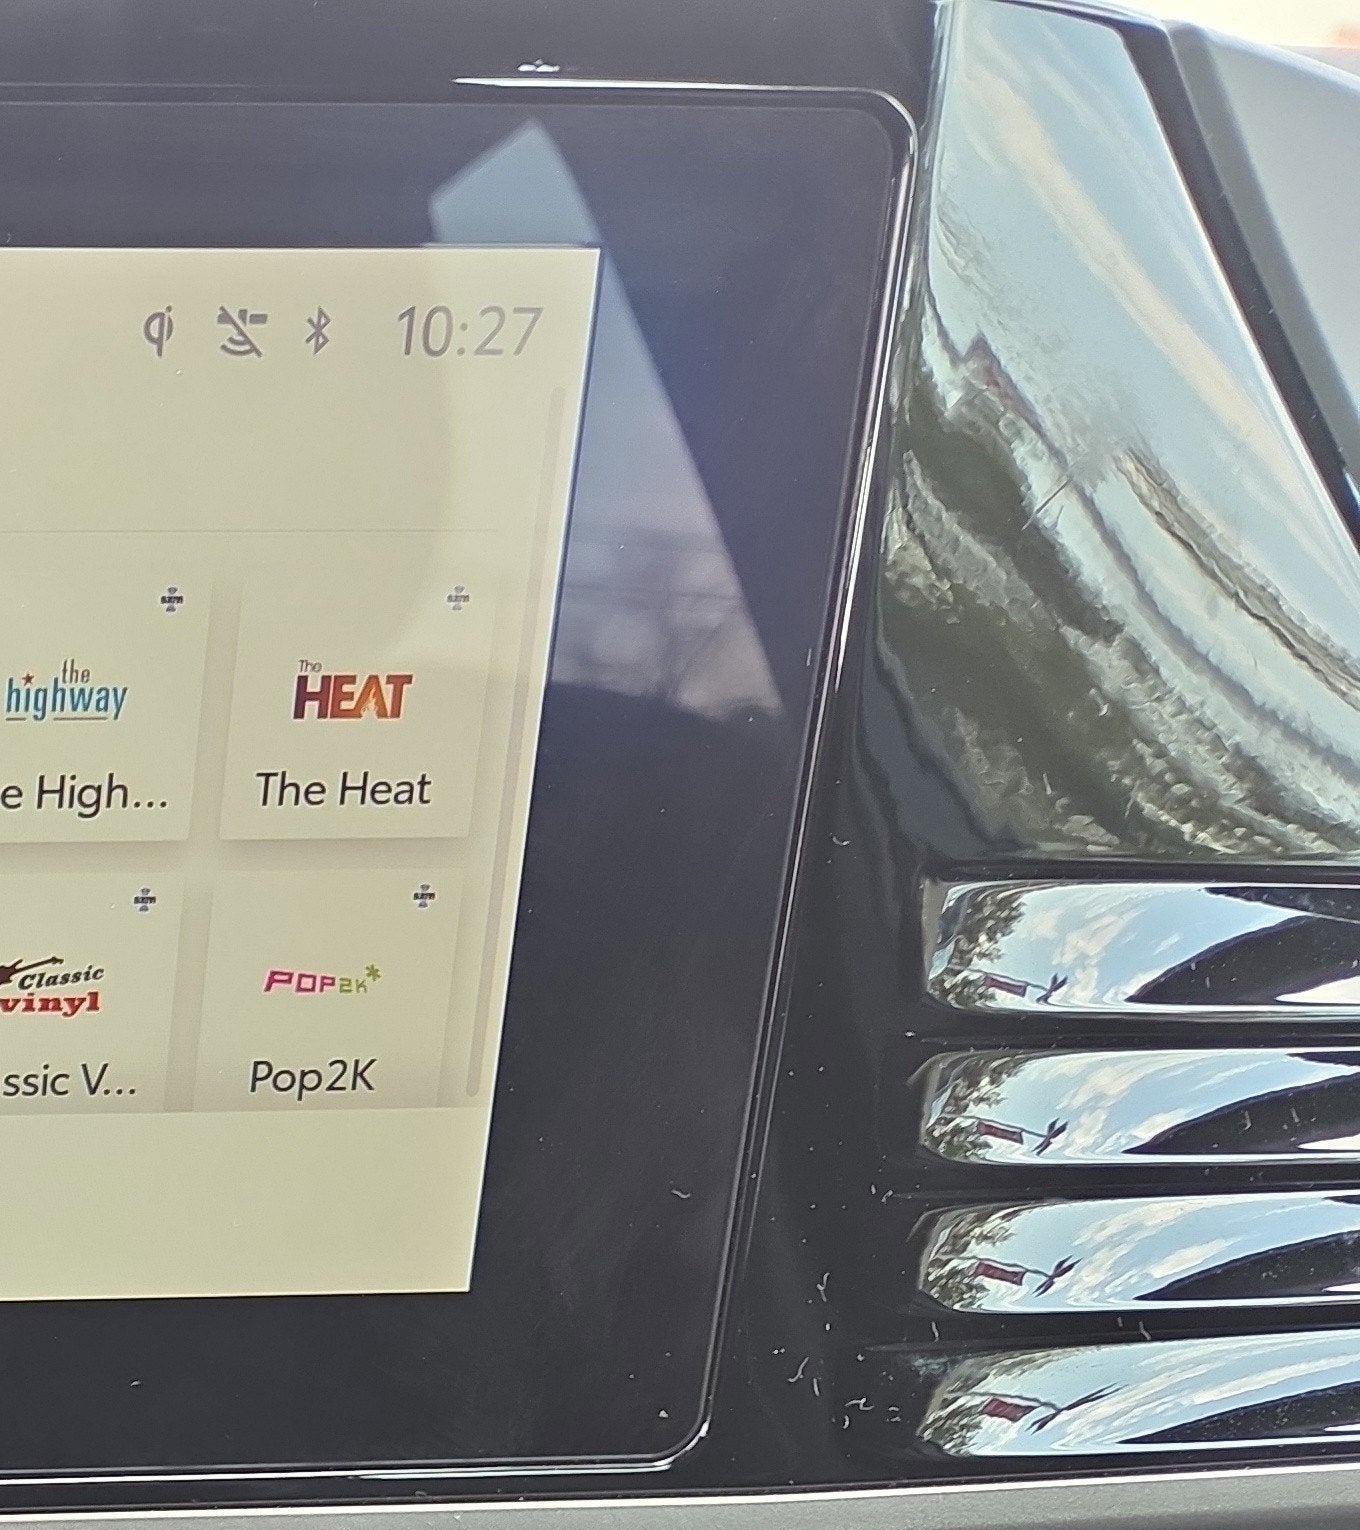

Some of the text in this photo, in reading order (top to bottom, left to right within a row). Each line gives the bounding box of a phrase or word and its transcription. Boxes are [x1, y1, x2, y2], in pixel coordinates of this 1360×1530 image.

[397, 304, 544, 358] 10:27
[61, 658, 91, 684] the
[299, 659, 323, 673] The
[5, 676, 128, 721] highway
[293, 673, 413, 720] HEAT
[256, 770, 432, 807] The Heat
[17, 964, 106, 991] Classic
[250, 1058, 377, 1102] Pop2K
